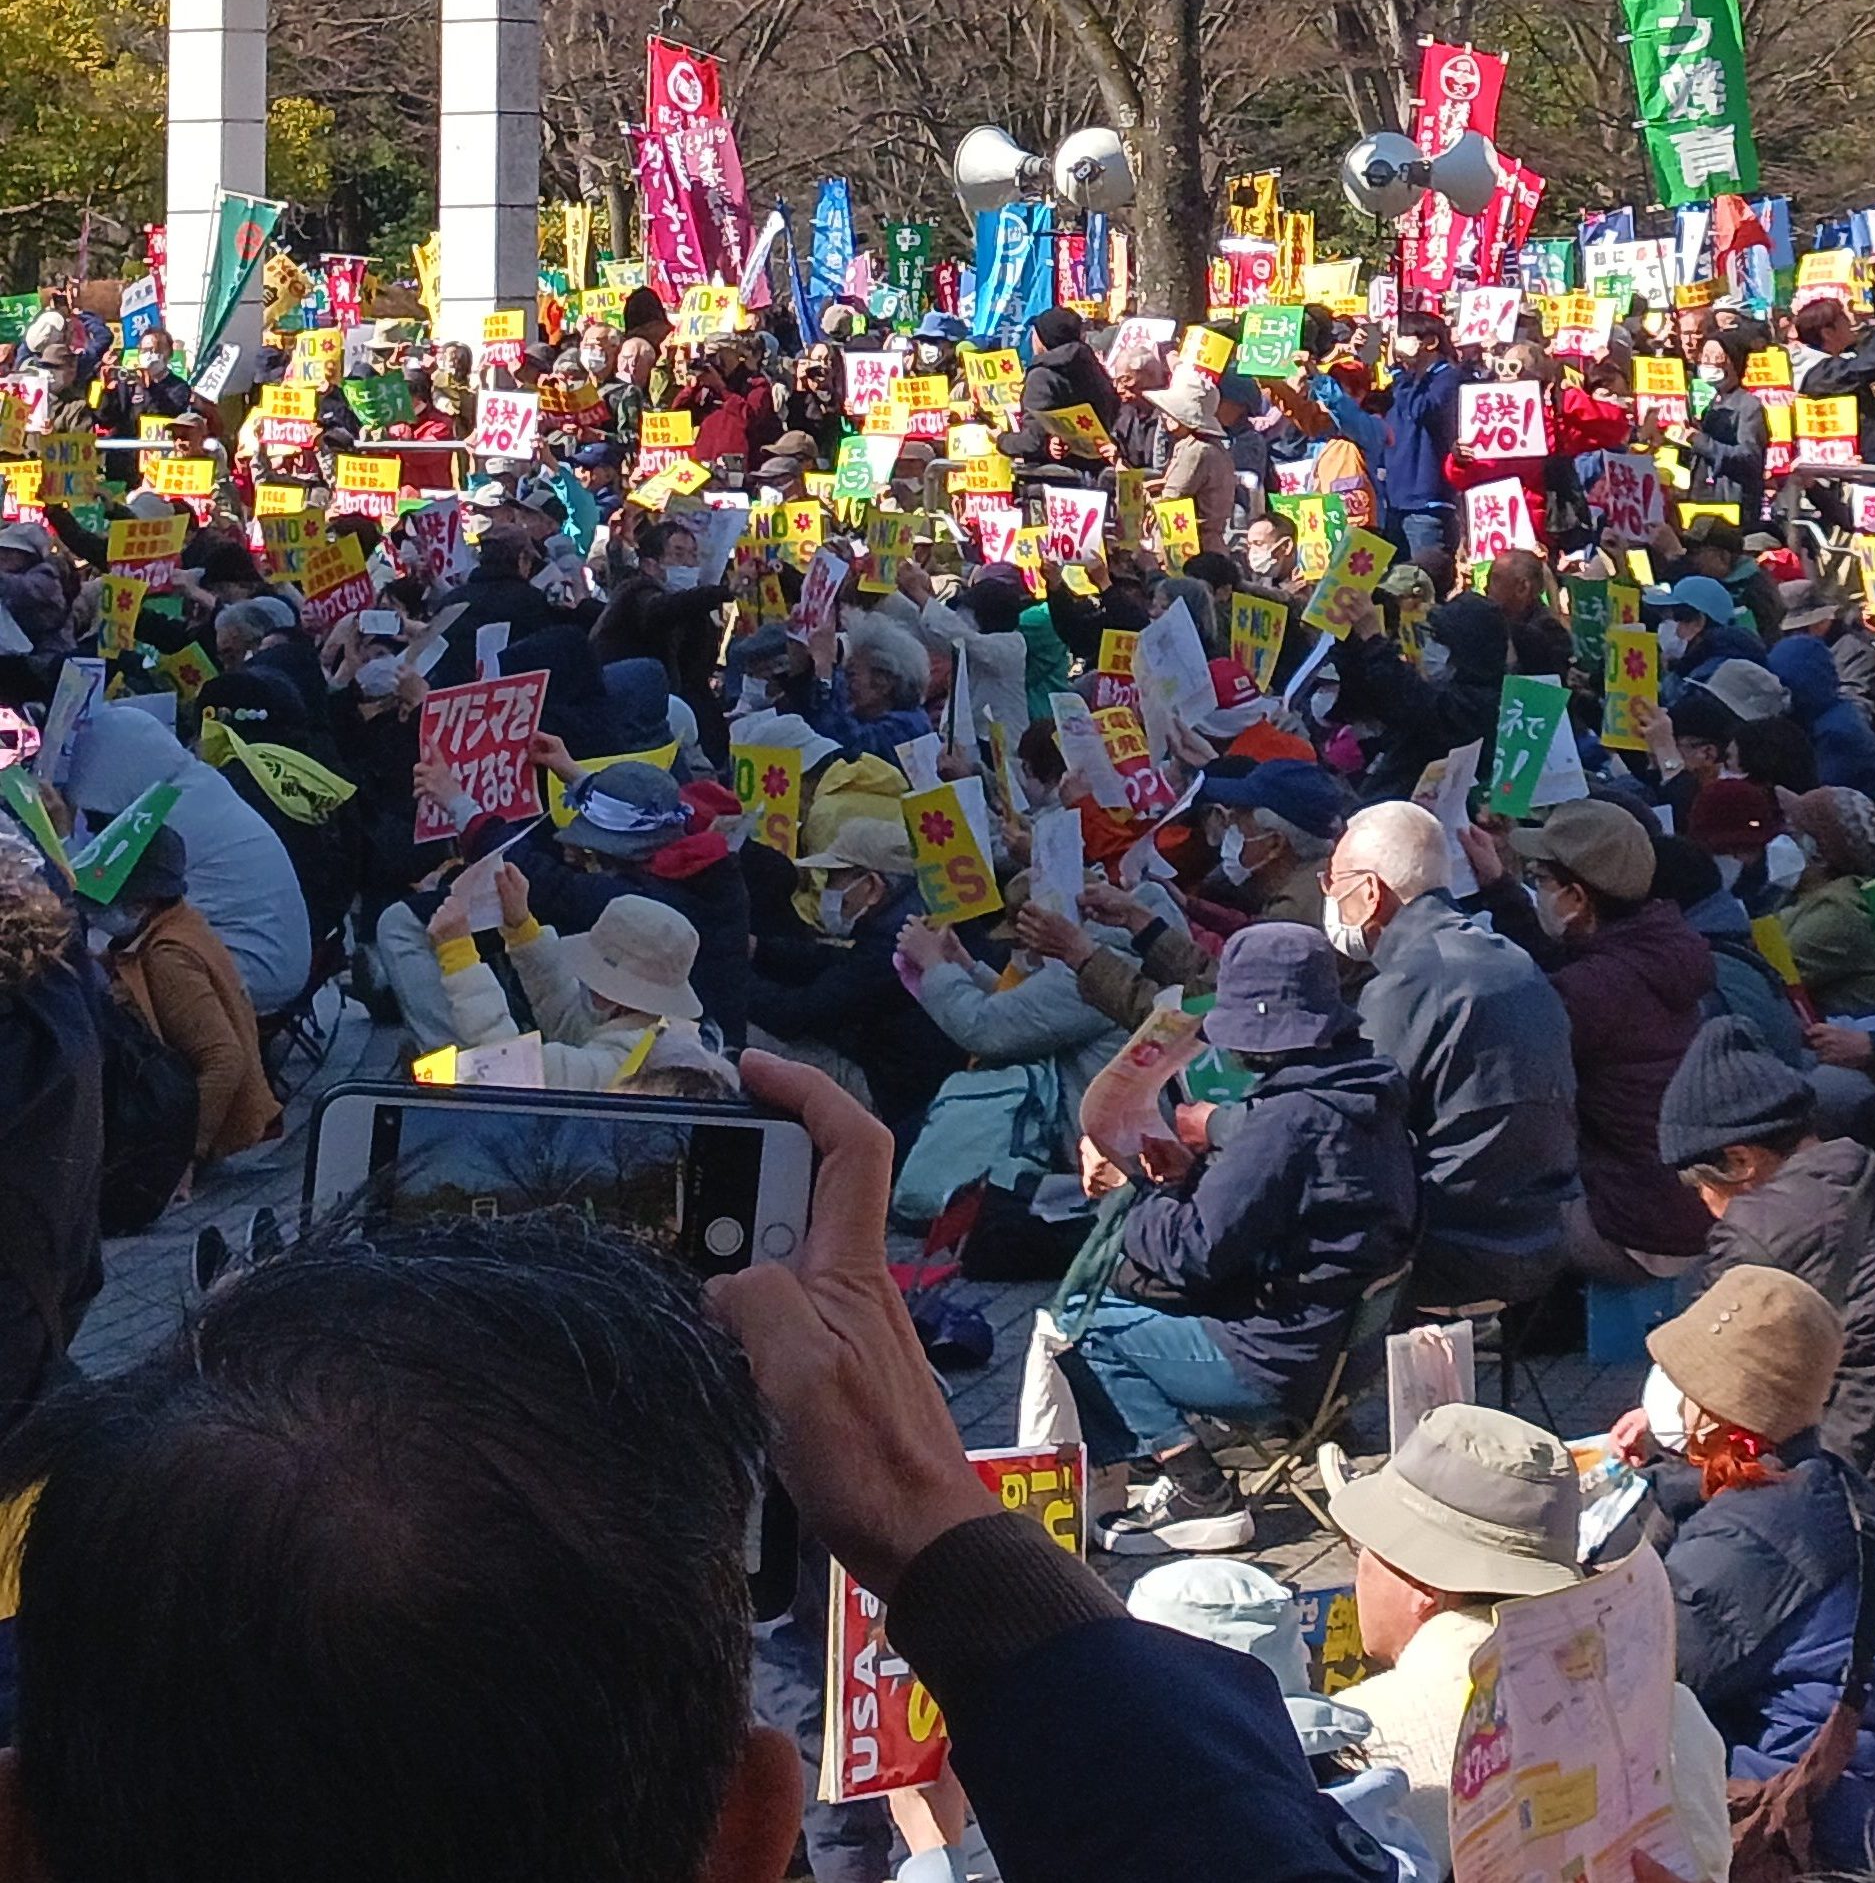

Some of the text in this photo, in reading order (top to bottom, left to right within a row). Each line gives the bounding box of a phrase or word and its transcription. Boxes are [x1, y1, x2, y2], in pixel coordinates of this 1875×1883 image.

[1471, 391, 1521, 425] 原発
[1471, 397, 1536, 451] NO!
[850, 1640, 880, 1786] USA
